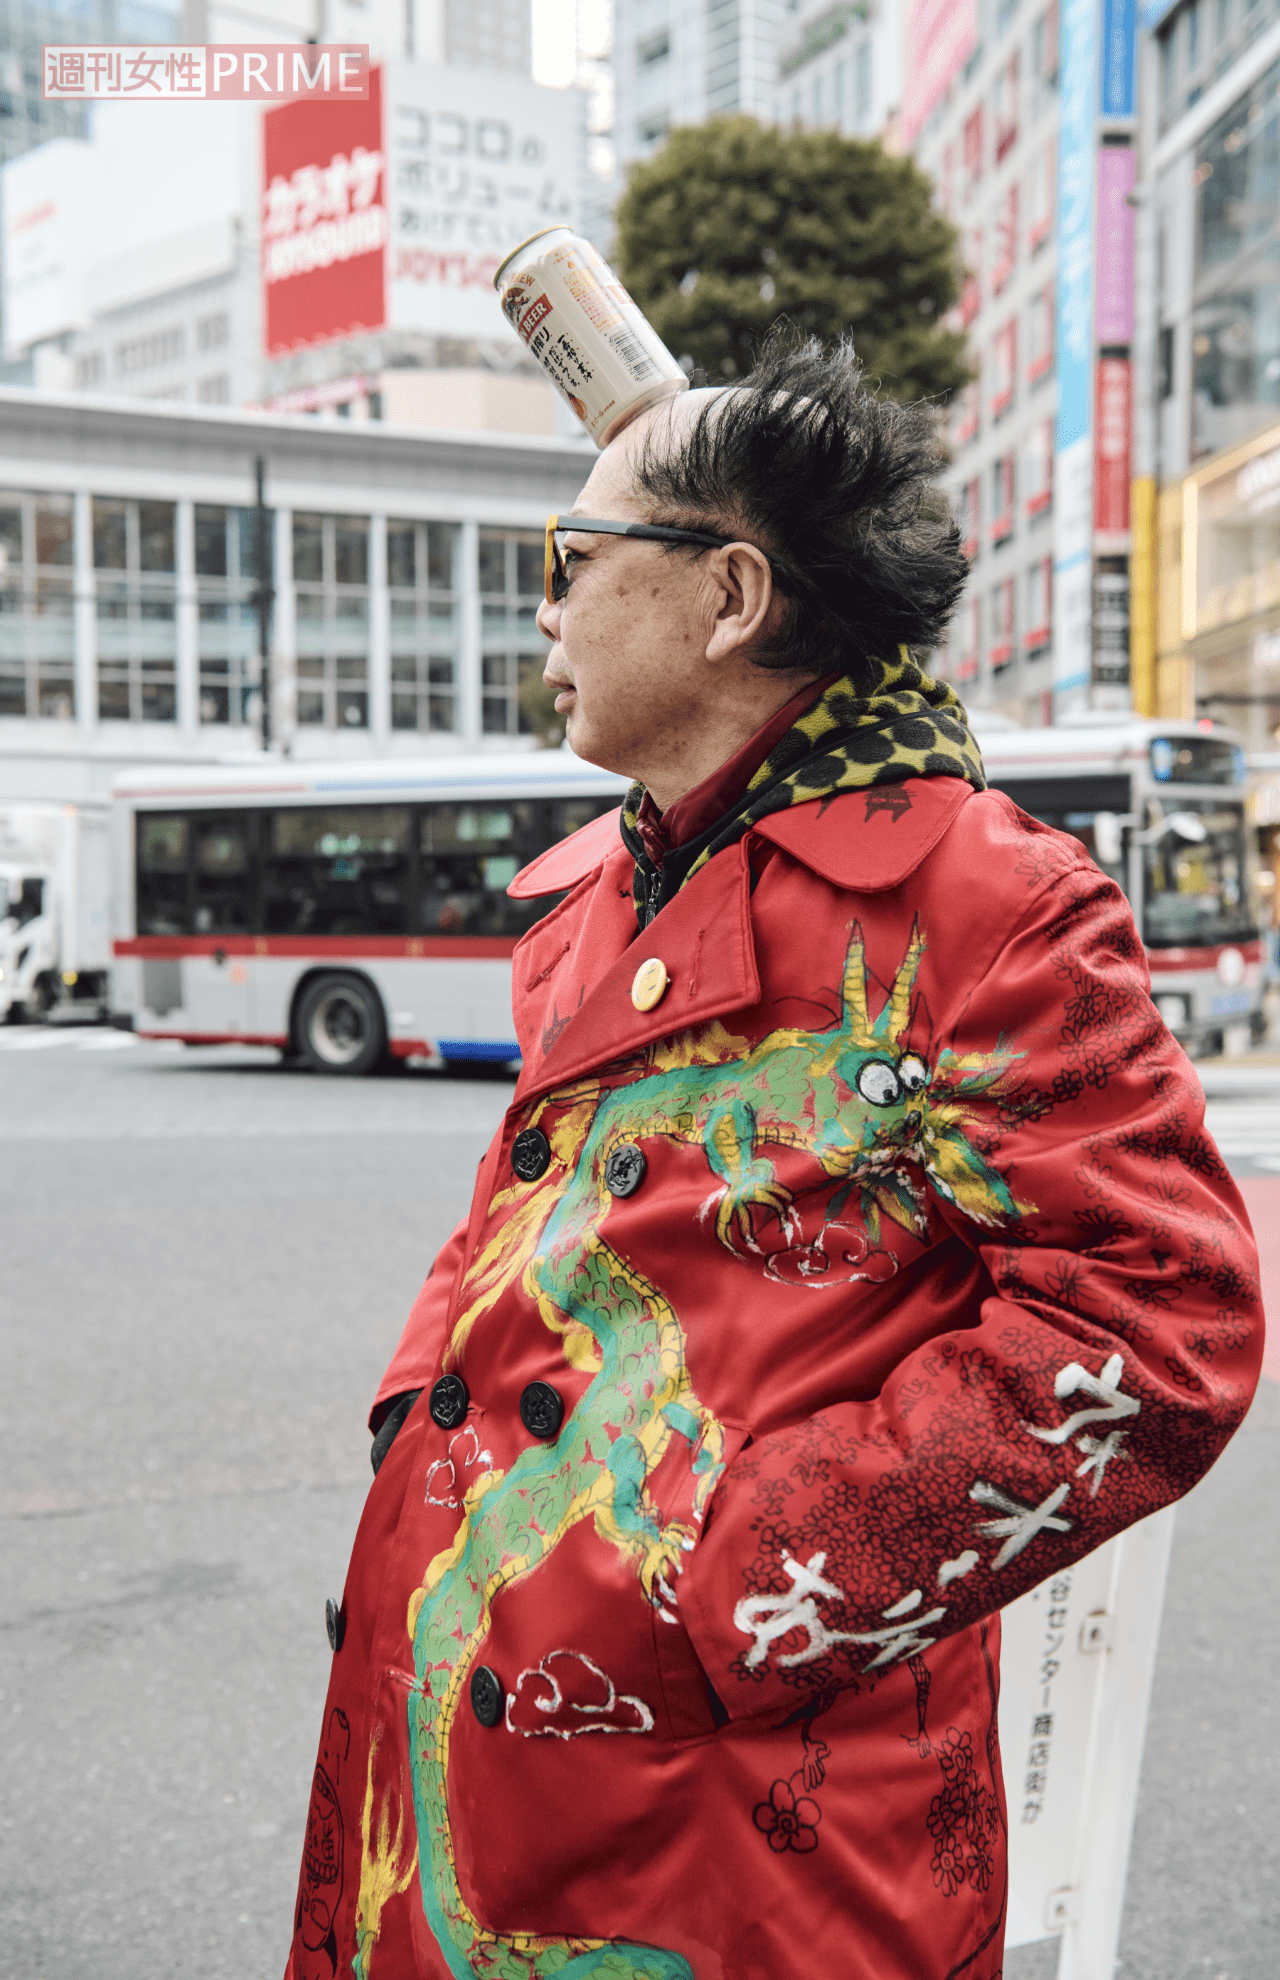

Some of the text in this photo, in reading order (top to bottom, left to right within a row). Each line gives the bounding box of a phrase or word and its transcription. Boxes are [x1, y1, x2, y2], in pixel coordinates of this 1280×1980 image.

[511, 273, 535, 287] BREW
[524, 303, 547, 332] BEER
[557, 334, 594, 383] 一番搾り麦汁
